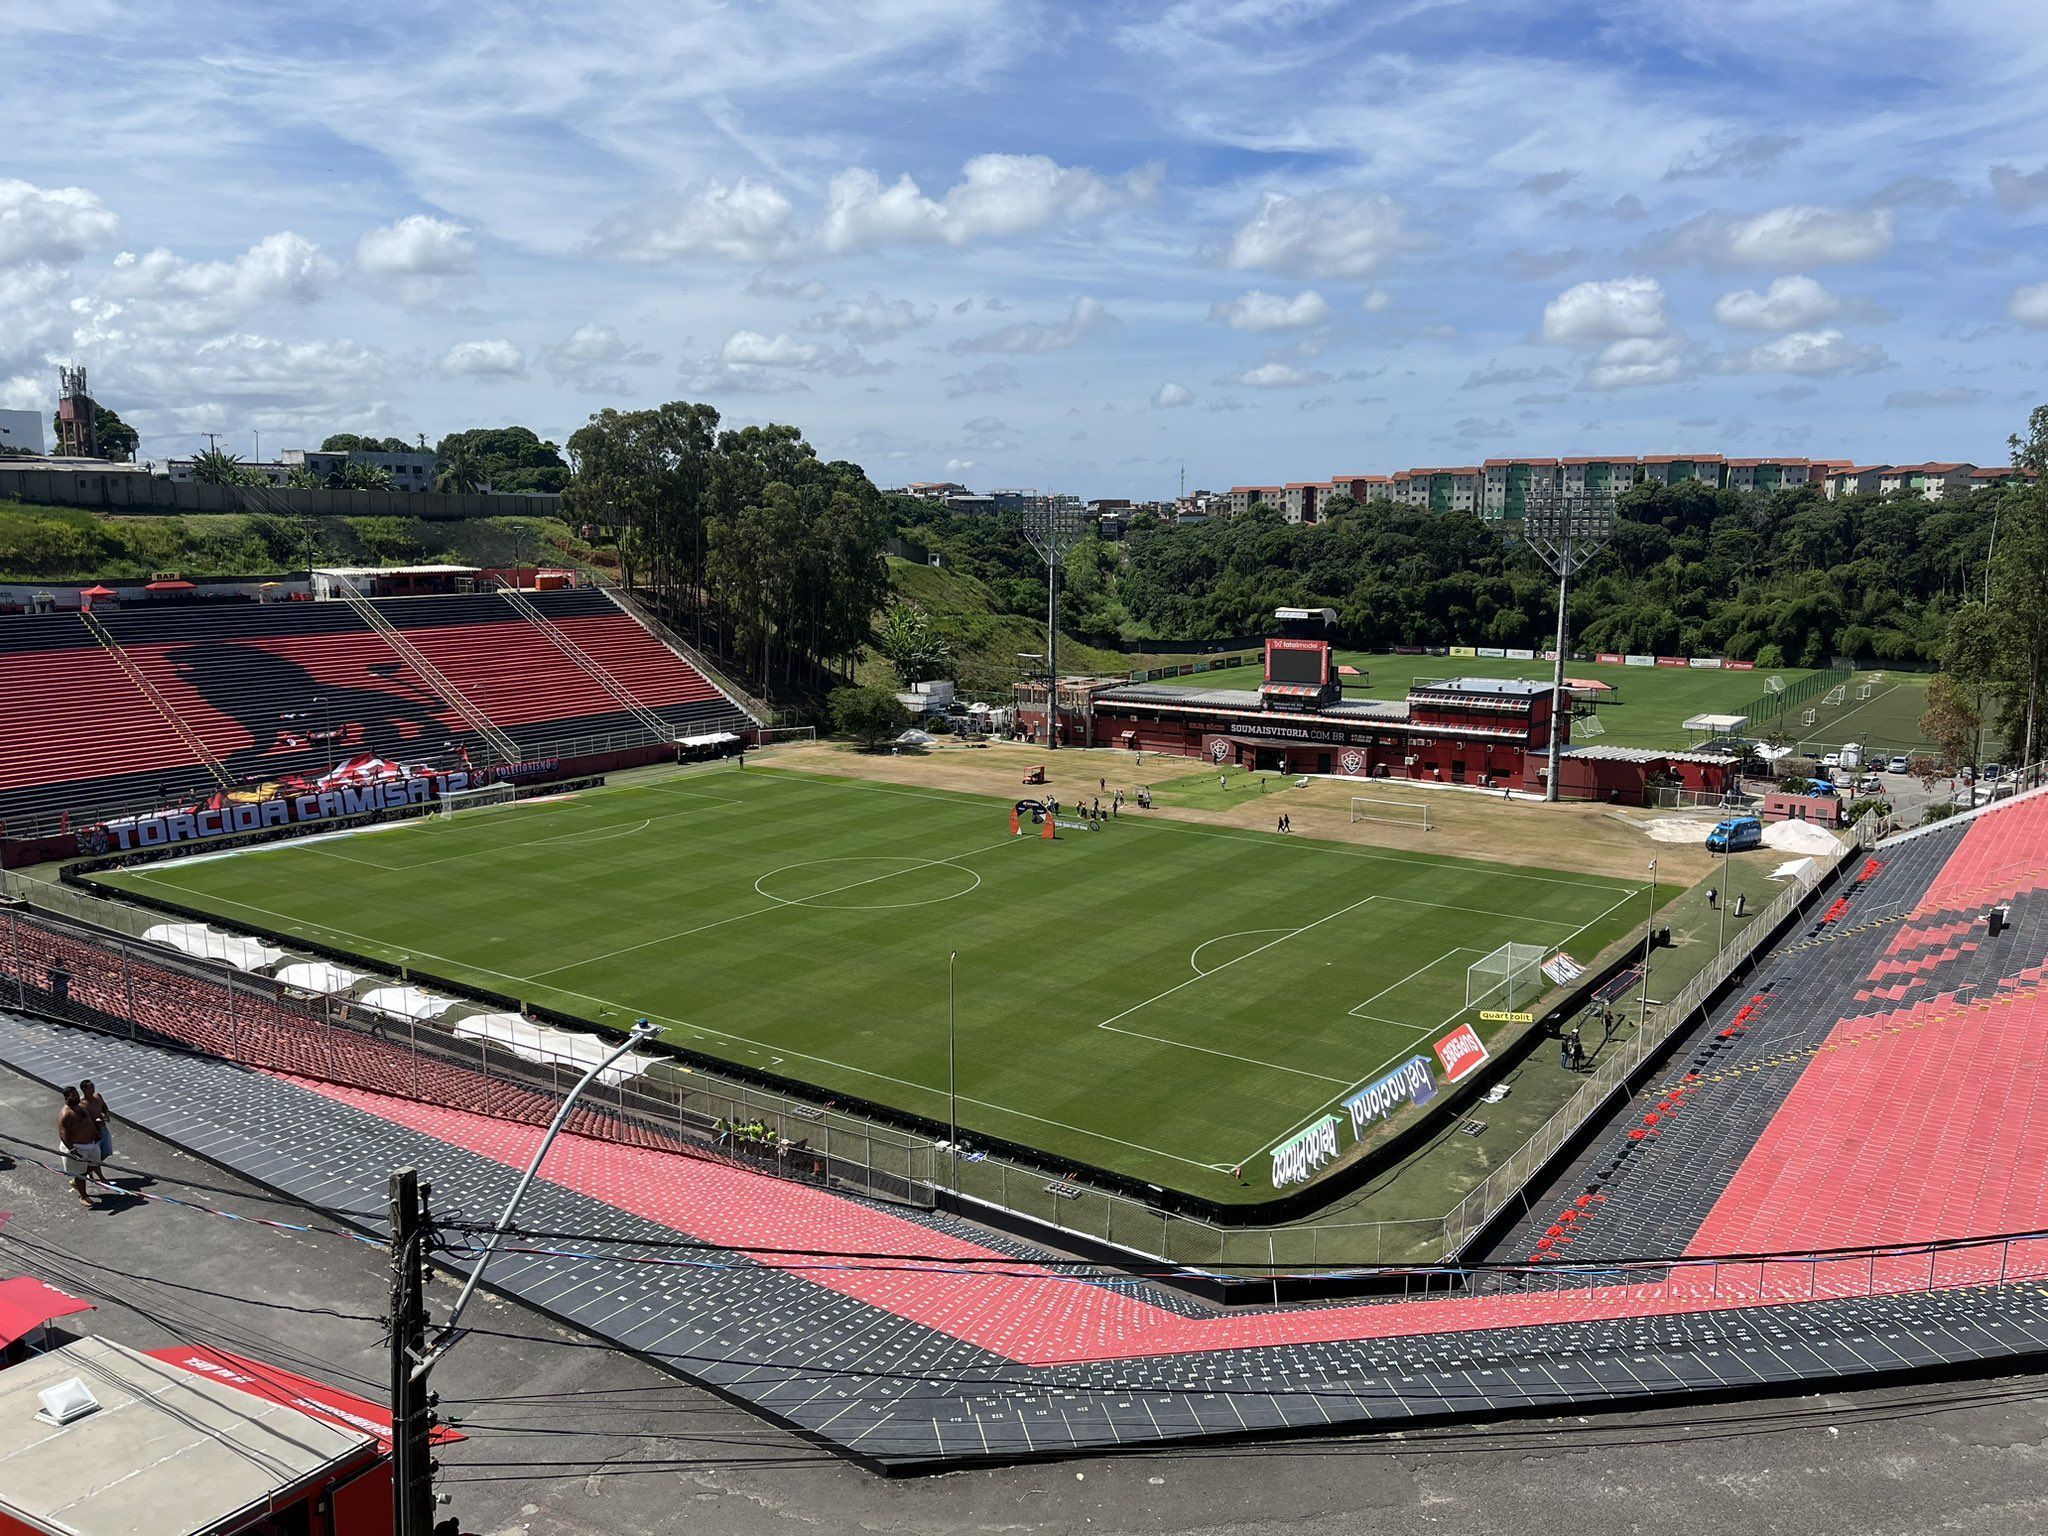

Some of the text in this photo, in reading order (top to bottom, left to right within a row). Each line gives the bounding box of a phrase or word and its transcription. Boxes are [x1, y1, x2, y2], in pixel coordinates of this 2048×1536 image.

[1231, 724, 1309, 738] SOUMAISVITORIA
[107, 772, 469, 850] TORCIDA CAMISA 12
[1482, 1012, 1531, 1021] quartzolit
[1440, 1033, 1479, 1073] SUPERBET
